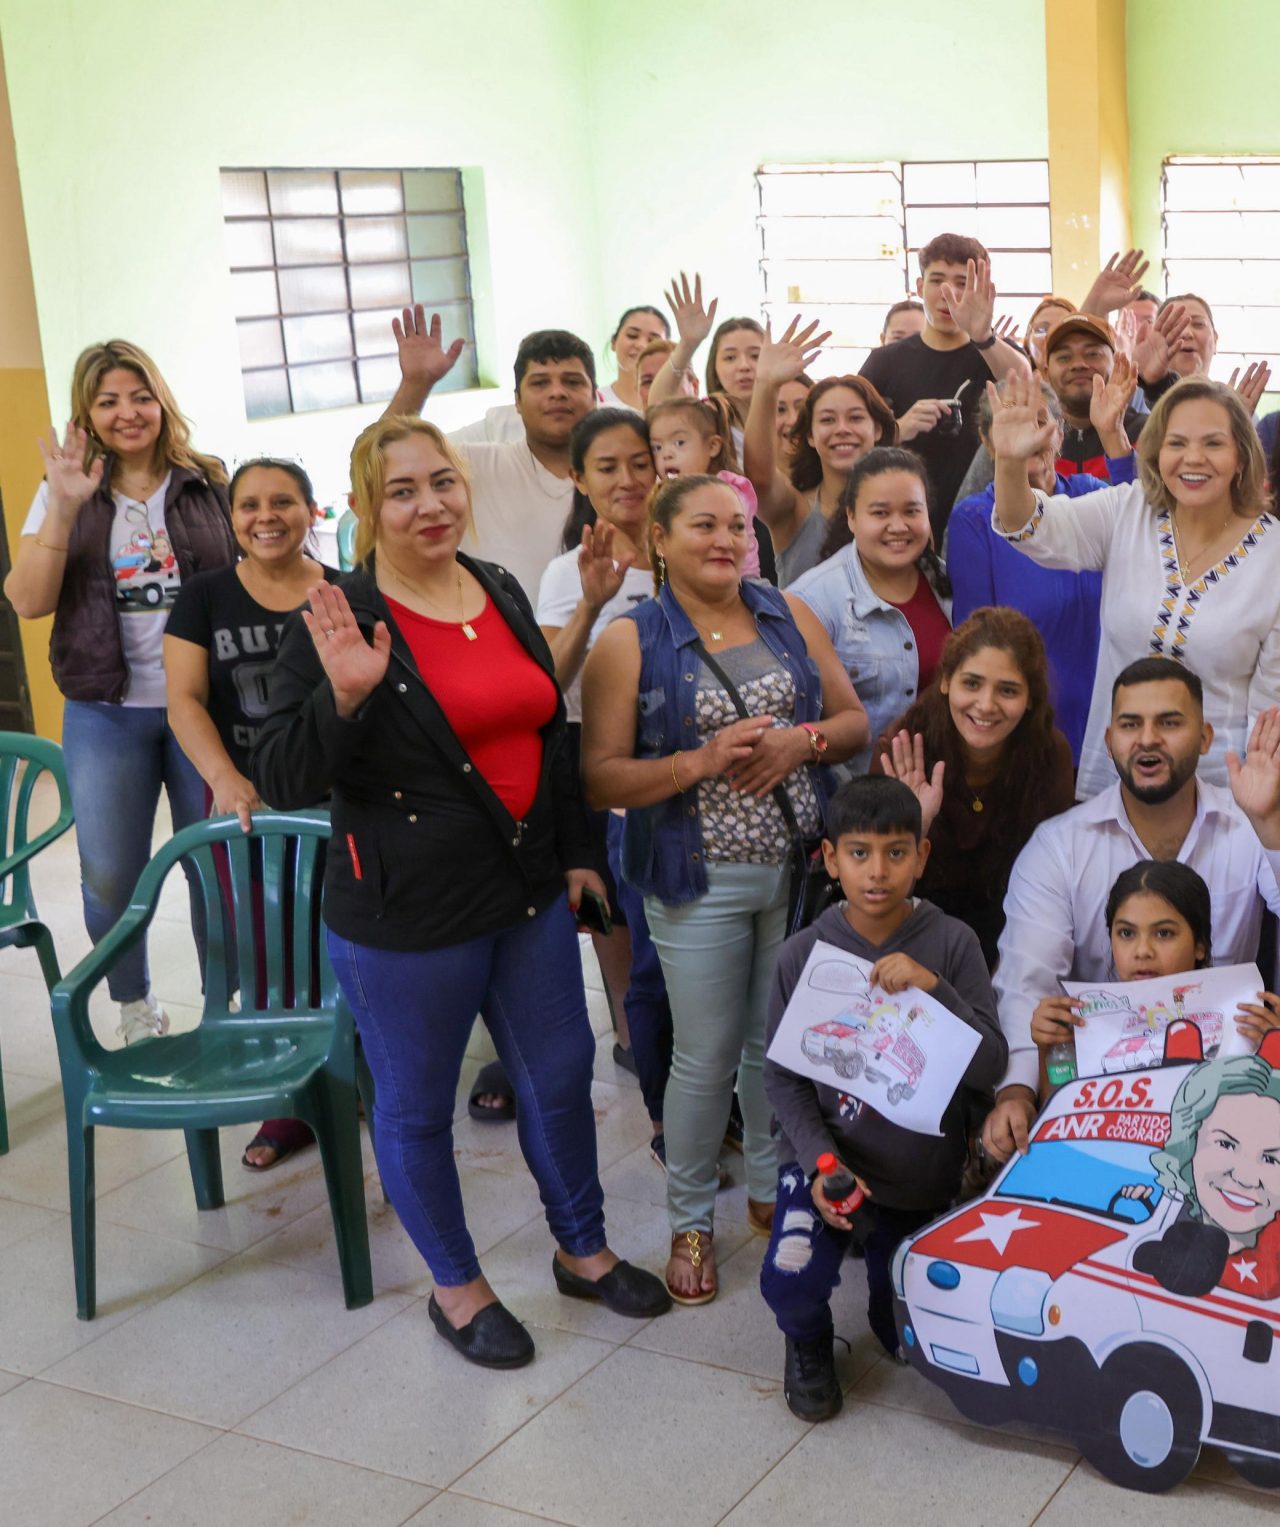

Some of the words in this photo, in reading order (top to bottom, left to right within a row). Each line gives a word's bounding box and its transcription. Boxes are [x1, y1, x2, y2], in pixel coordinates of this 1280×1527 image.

[1073, 1077, 1154, 1109] S.O.S.
[1044, 1114, 1105, 1139] ANR
[1117, 1114, 1171, 1129] PARTIDO
